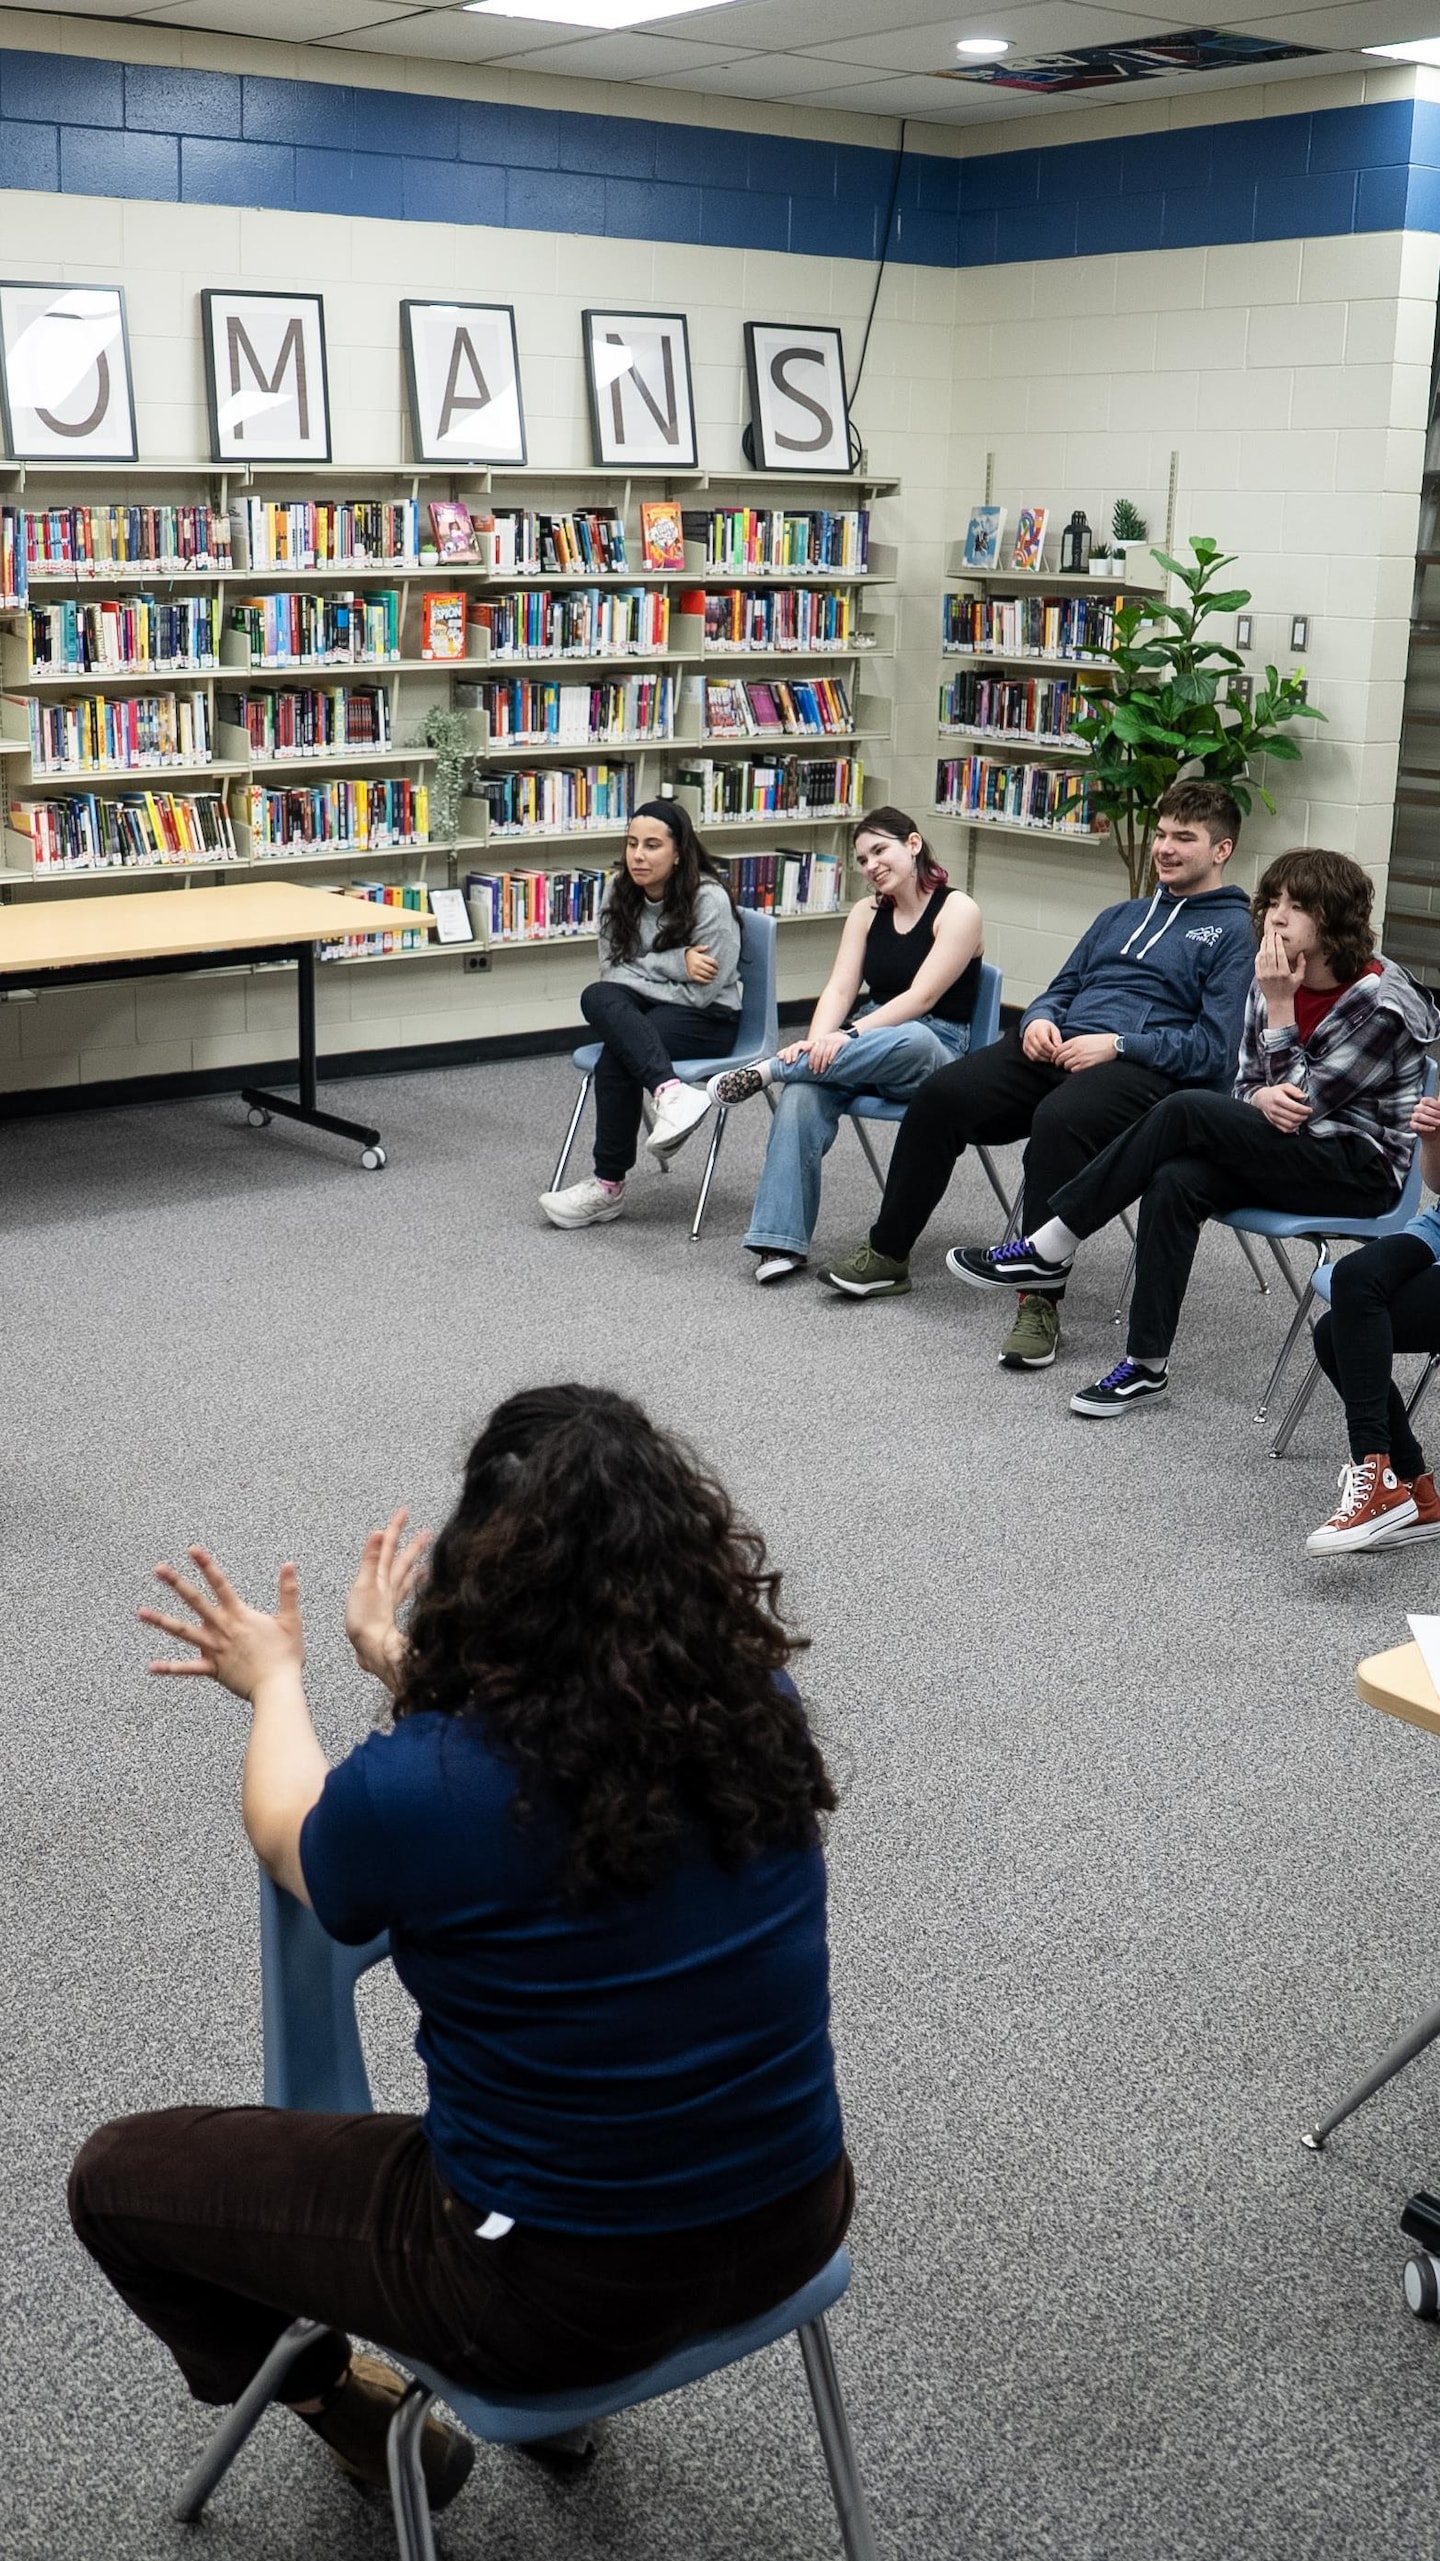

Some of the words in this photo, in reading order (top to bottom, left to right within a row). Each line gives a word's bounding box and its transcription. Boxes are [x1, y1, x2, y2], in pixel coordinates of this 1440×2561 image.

[226, 316, 310, 440] M
[437, 326, 500, 441] A
[606, 333, 680, 446] N
[770, 347, 834, 453] S
